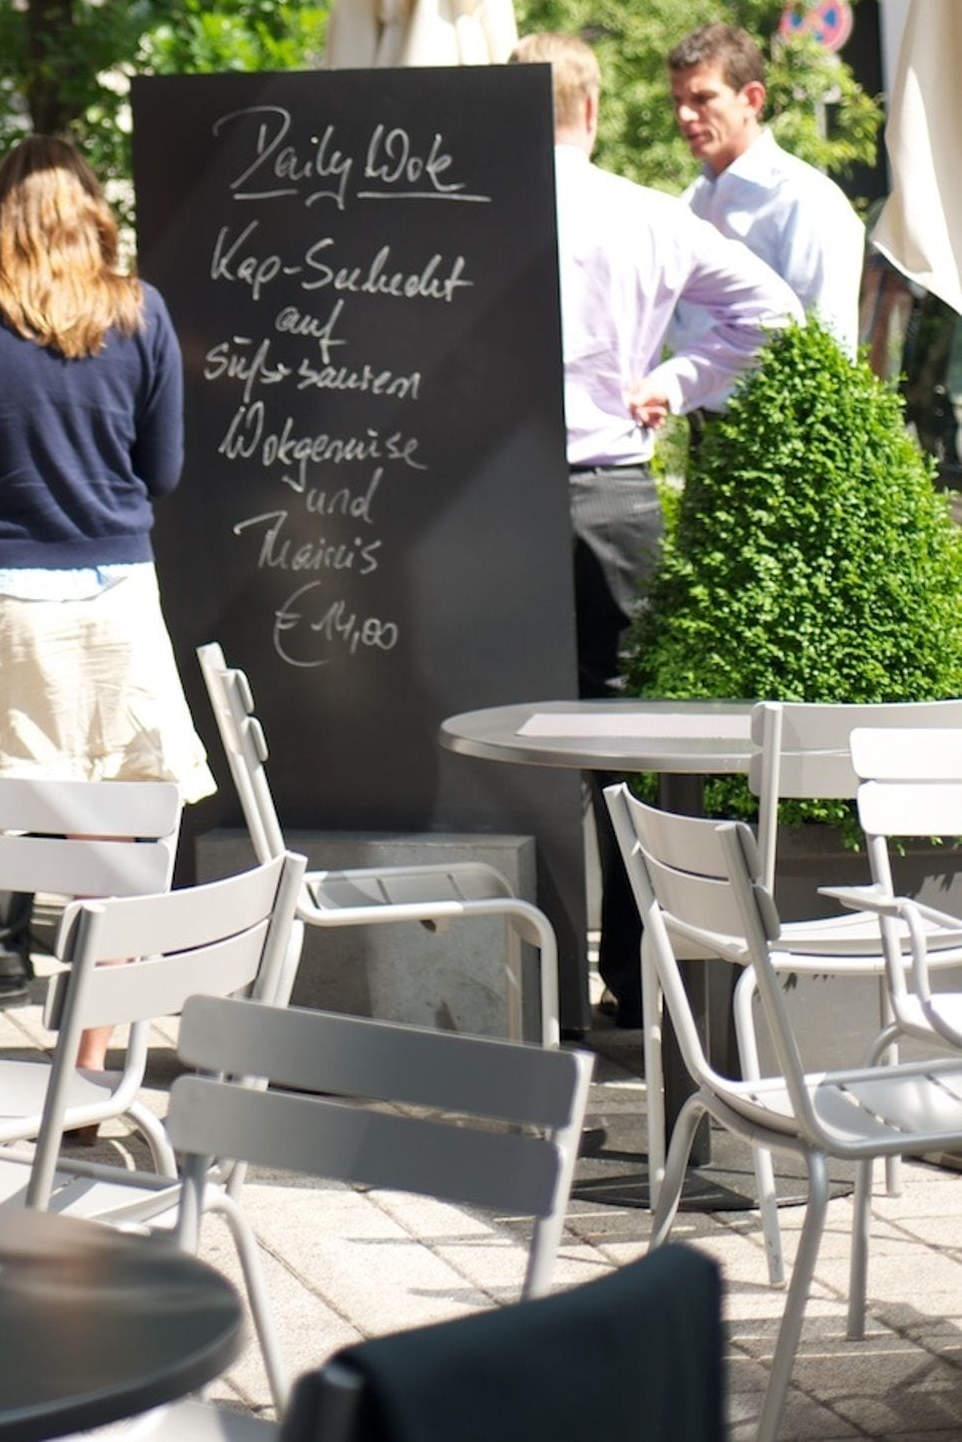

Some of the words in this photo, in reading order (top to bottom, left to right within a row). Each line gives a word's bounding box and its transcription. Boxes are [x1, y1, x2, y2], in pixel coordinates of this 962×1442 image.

[212, 105, 354, 210] Daily
[364, 123, 467, 193] Wok
[275, 299, 346, 364] auf
[305, 468, 384, 523] und
